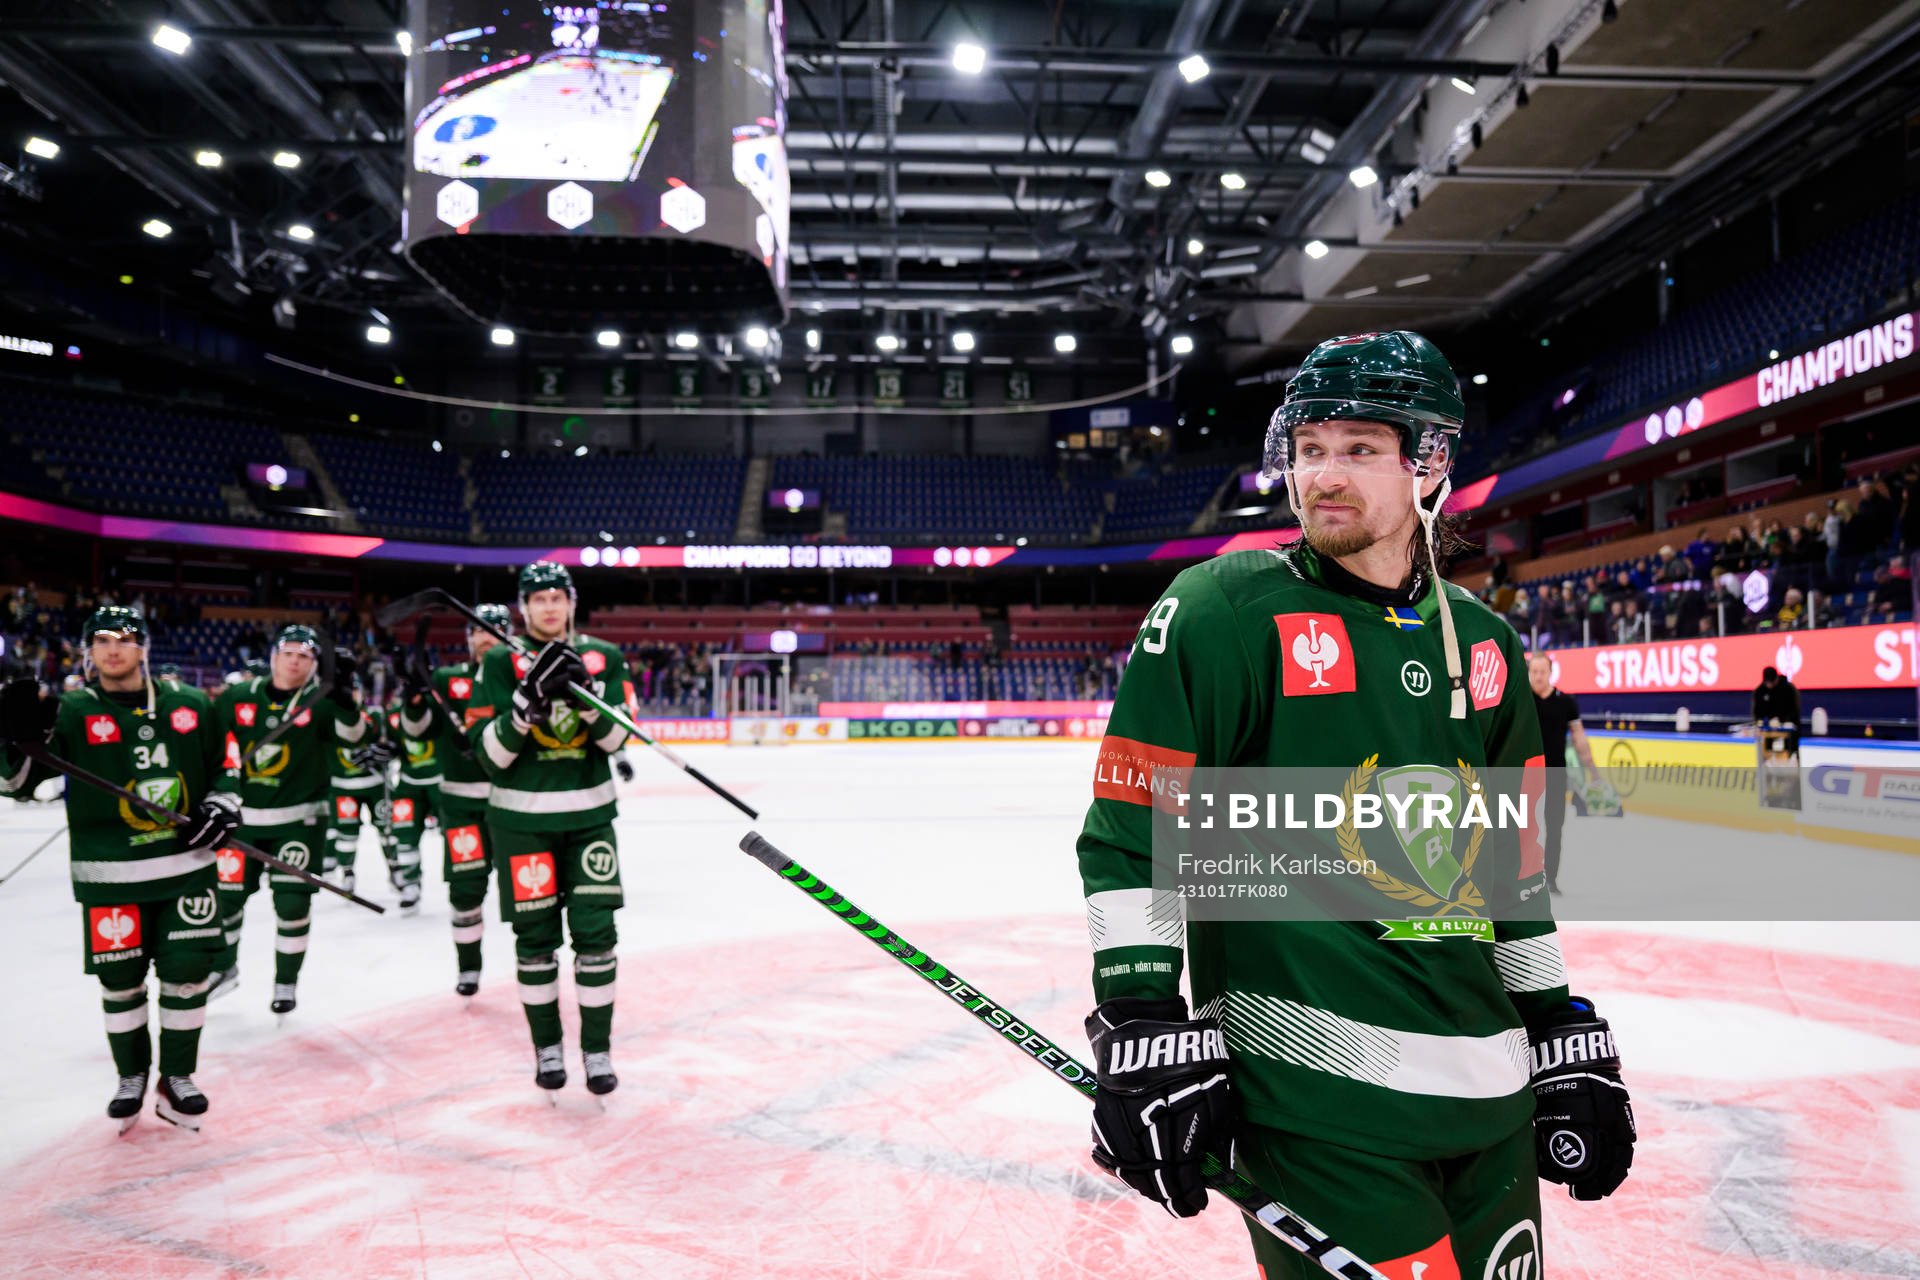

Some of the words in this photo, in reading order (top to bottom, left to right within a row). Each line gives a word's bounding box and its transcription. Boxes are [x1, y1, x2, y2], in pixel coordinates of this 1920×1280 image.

[1757, 313, 1914, 407] CHAMPIONS
[878, 377, 900, 398] 19
[943, 378, 965, 398] 21
[683, 546, 790, 568] CHAMPIONS
[791, 546, 818, 568] GO
[819, 546, 892, 568] BEYOND
[1471, 649, 1500, 701] CHL
[1595, 643, 1719, 688] STRAUSS
[133, 743, 169, 770] 34
[1101, 750, 1183, 776] VOKATFIRMAN
[1096, 763, 1182, 799] LLIANS
[1808, 765, 1886, 799] GT
[1413, 921, 1487, 932] KARLSTAD
[92, 948, 143, 964] STRAUSS
[935, 977, 1084, 1082] JETSPEED
[1556, 1082, 1578, 1091] PRO
[1183, 1112, 1201, 1155] COVERT
